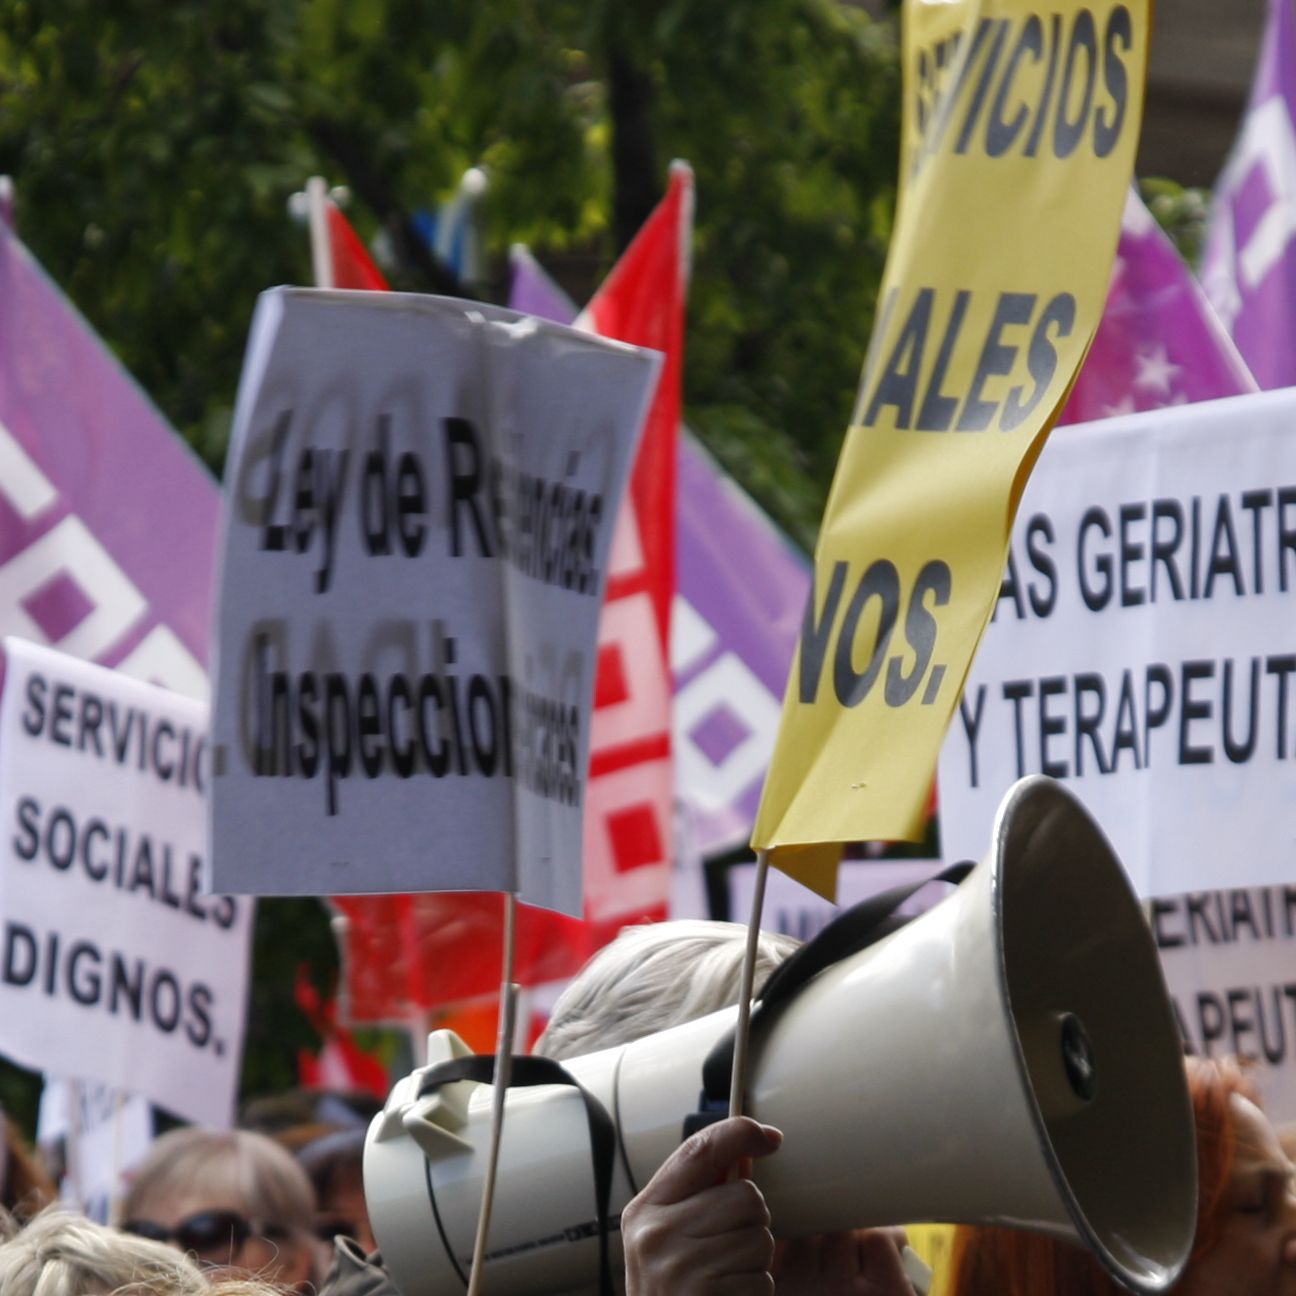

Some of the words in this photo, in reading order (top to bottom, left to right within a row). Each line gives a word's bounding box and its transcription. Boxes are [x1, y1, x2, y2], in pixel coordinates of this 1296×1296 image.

[257, 407, 352, 595] Ley
[359, 413, 428, 559] de
[959, 683, 989, 789] Y
[2, 921, 226, 1057] DIGNOS.
